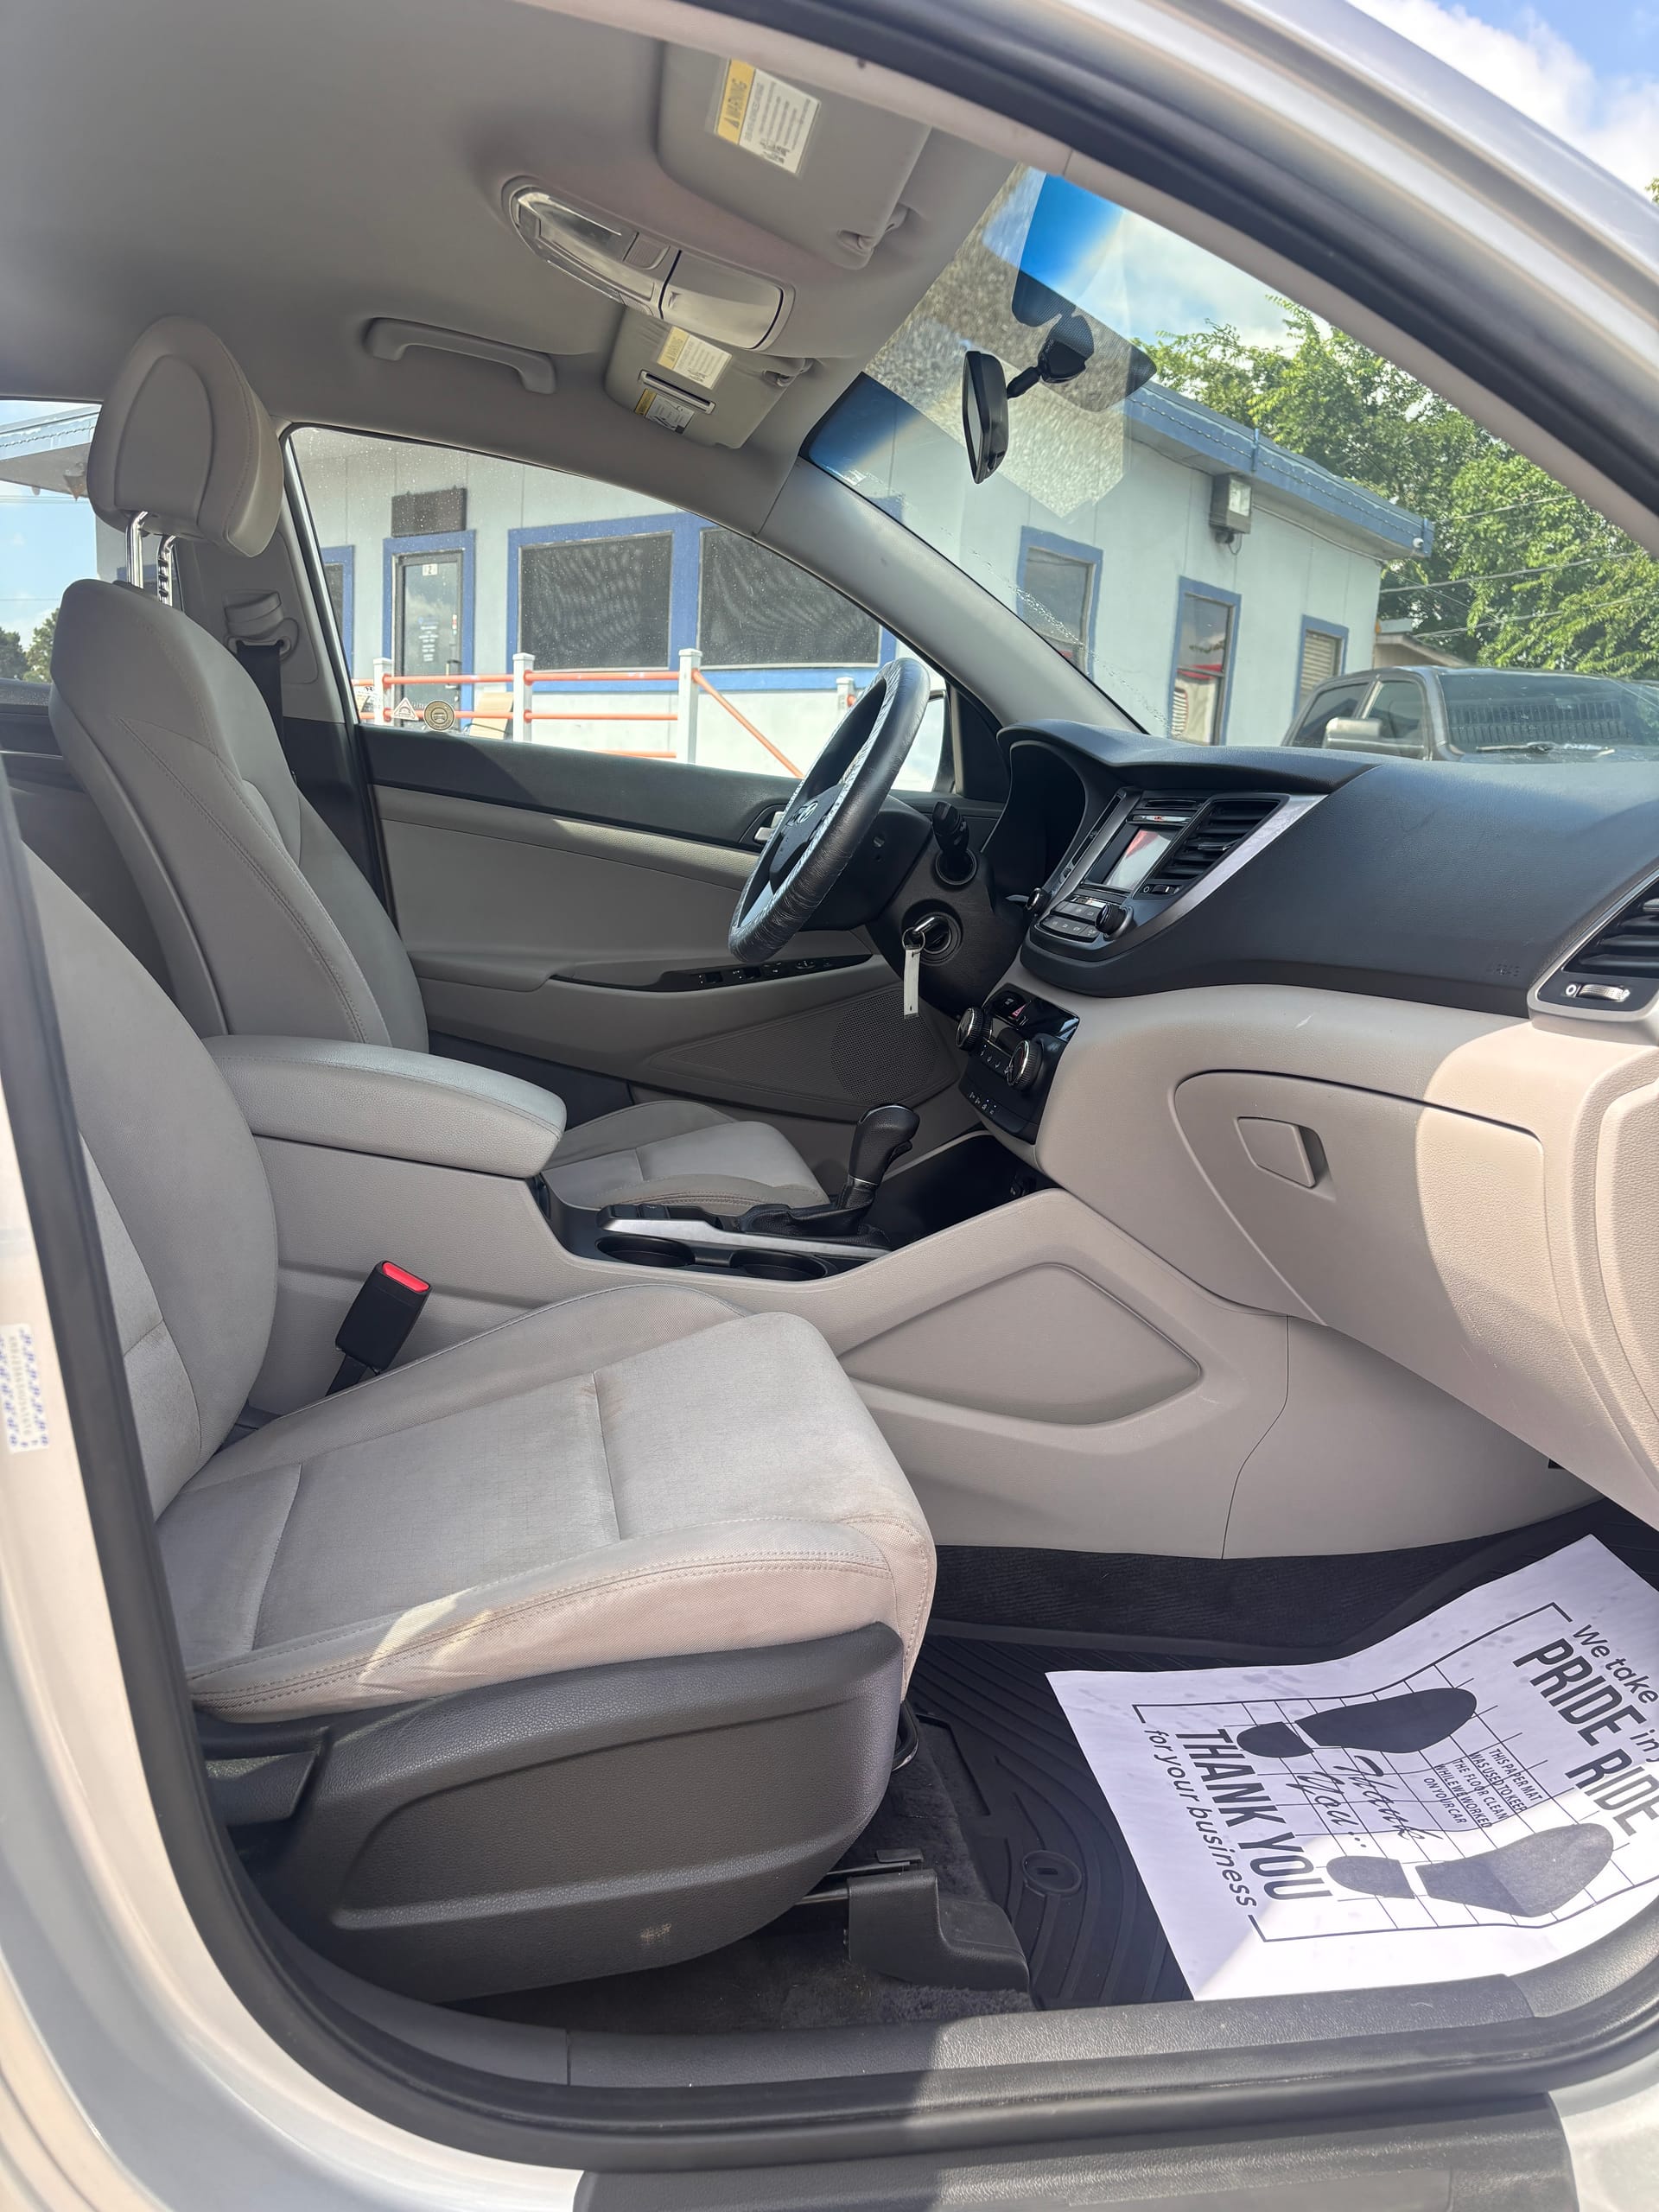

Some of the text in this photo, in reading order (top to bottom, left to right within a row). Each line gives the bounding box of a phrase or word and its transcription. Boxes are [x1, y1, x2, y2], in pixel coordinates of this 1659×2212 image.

[1512, 1637, 1659, 1752] PRIDE in
[1573, 1624, 1659, 1704] We take
[1175, 1728, 1334, 1901] THANK YOU
[1333, 1755, 1444, 1840] Thank
[1423, 1777, 1467, 1824] ON YOUR CAR
[1434, 1764, 1460, 1788] WHILE
[1460, 1796, 1493, 1828] WORKED
[1452, 1758, 1510, 1820] THE FLOOR CLEAN
[1469, 1751, 1529, 1813] WAS USED TO KEEP
[1489, 1748, 1543, 1801] THIS PAPER MAT
[1565, 1748, 1659, 1837] RIDE
[1144, 1730, 1258, 1907] for your business
